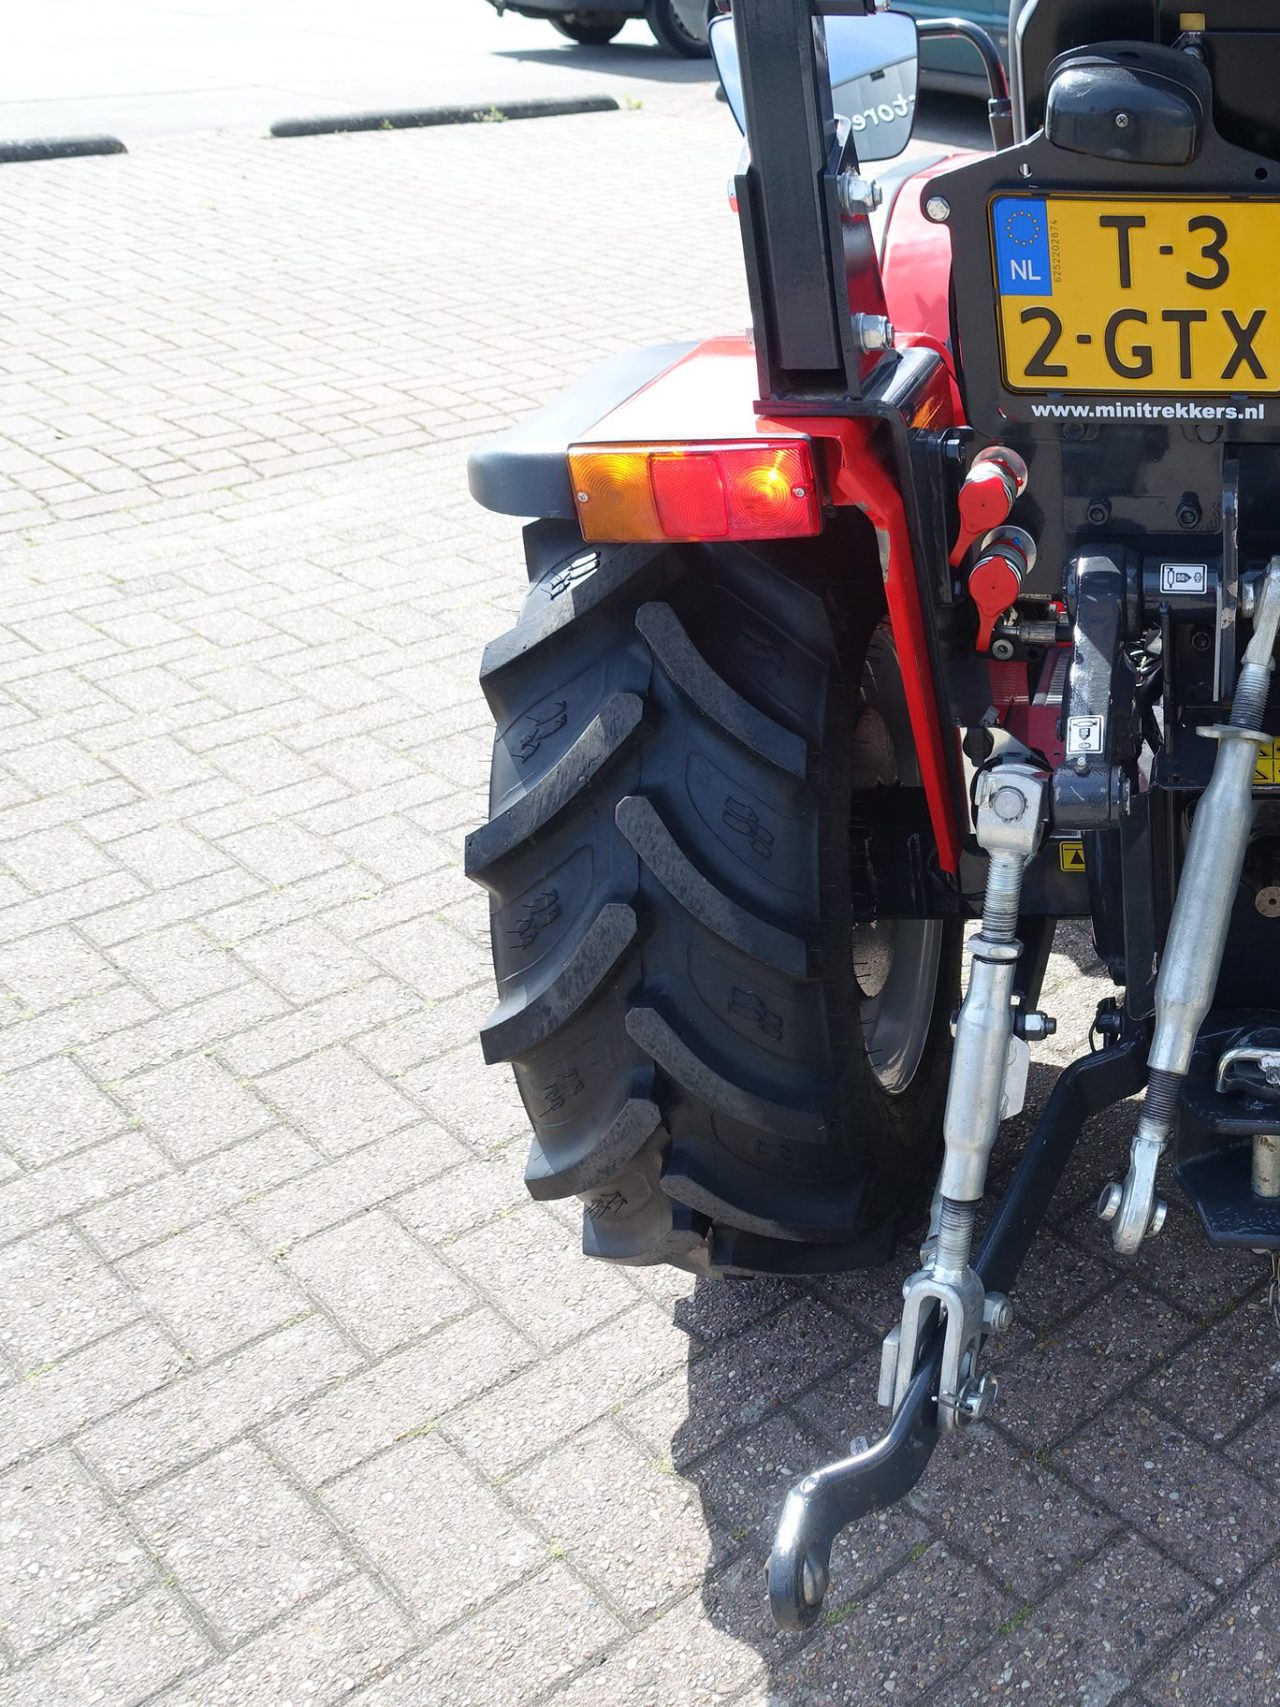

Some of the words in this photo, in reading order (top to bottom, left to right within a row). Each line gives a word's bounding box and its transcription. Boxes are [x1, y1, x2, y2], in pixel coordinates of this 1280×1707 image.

[1010, 259, 1042, 281] NL
[1099, 215, 1230, 290] T-3
[1020, 306, 1268, 380] 2-GTX
[1031, 402, 1265, 420] www.minitrekkers.nl
